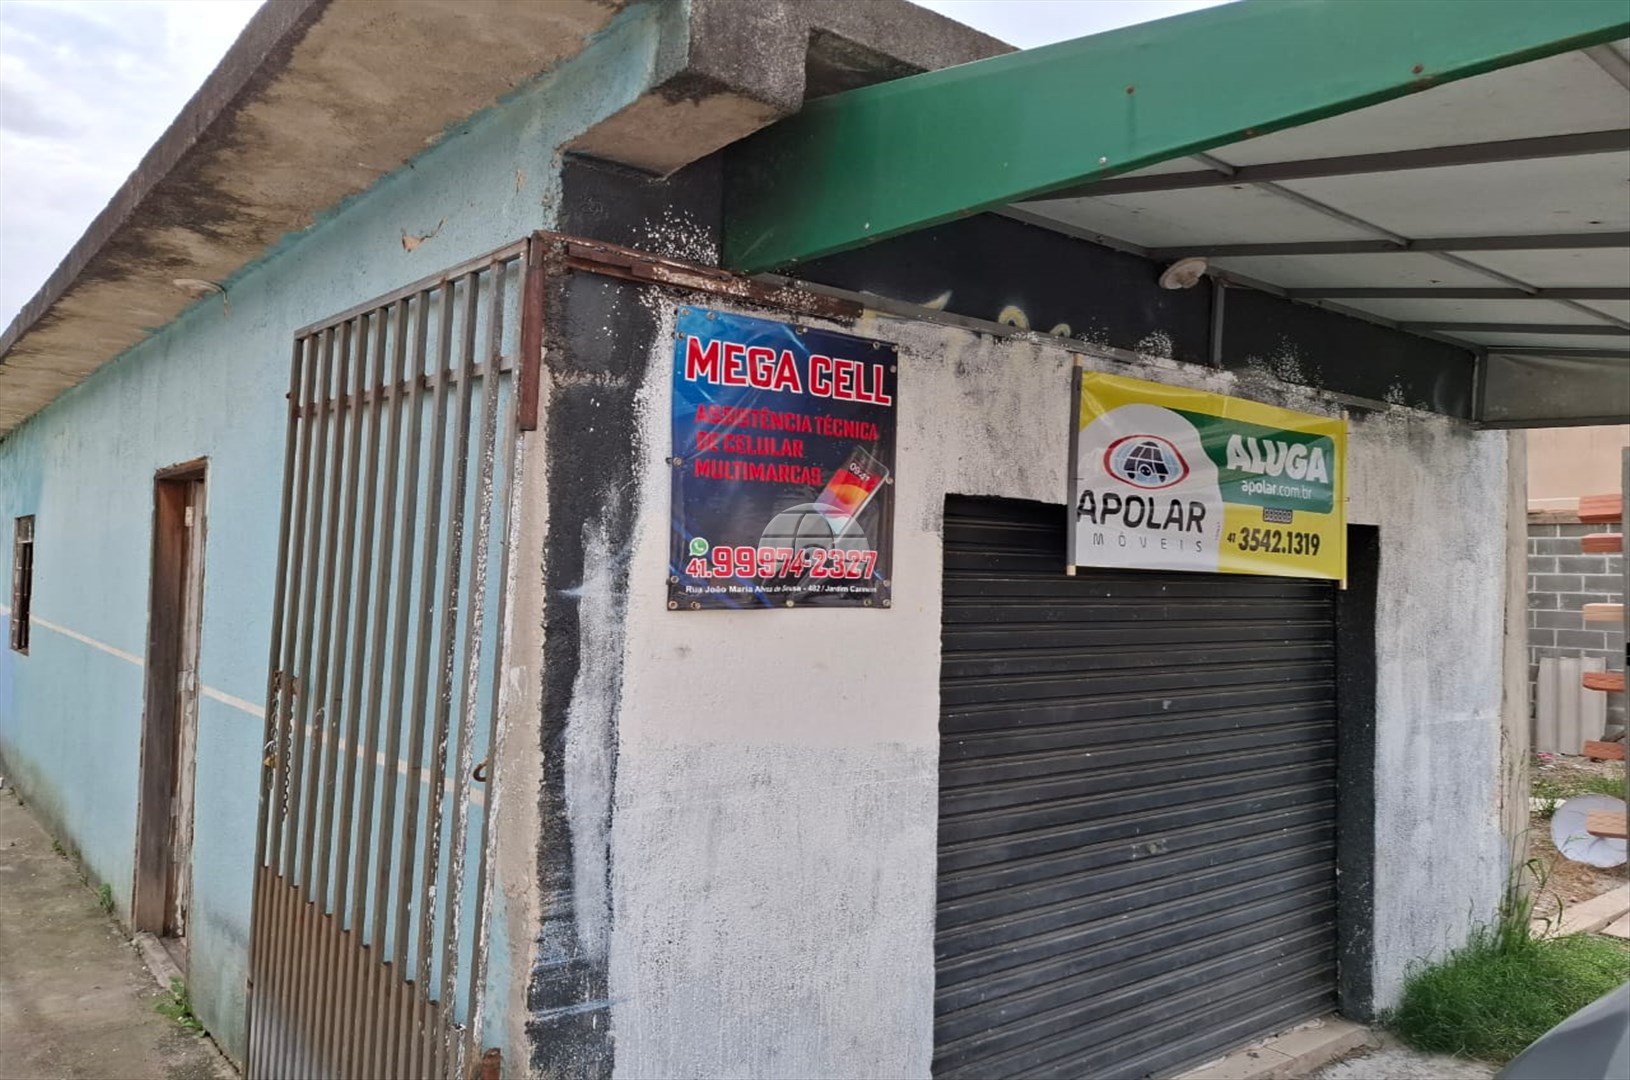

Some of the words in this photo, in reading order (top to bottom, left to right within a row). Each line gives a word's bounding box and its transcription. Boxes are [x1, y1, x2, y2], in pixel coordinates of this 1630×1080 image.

[685, 335, 803, 393] MEGA
[808, 354, 892, 406] CELL
[695, 404, 812, 433] ASSISTÊNCIA
[814, 414, 878, 441] TÉCNICA
[696, 431, 720, 452] DE
[723, 434, 803, 458] CELULAR
[694, 458, 823, 486] MULTIMARCAS
[1226, 434, 1329, 484] ALUGA
[1241, 480, 1312, 499] apolar.com.br
[1076, 489, 1206, 533] APOLAR
[1093, 532, 1202, 552] MÓVEIS
[1227, 532, 1236, 543] 41
[1238, 527, 1320, 555] 3542.1319
[686, 585, 703, 593] Rua
[705, 585, 727, 593] João
[729, 585, 753, 593] Maria
[825, 585, 849, 593] Jardim
